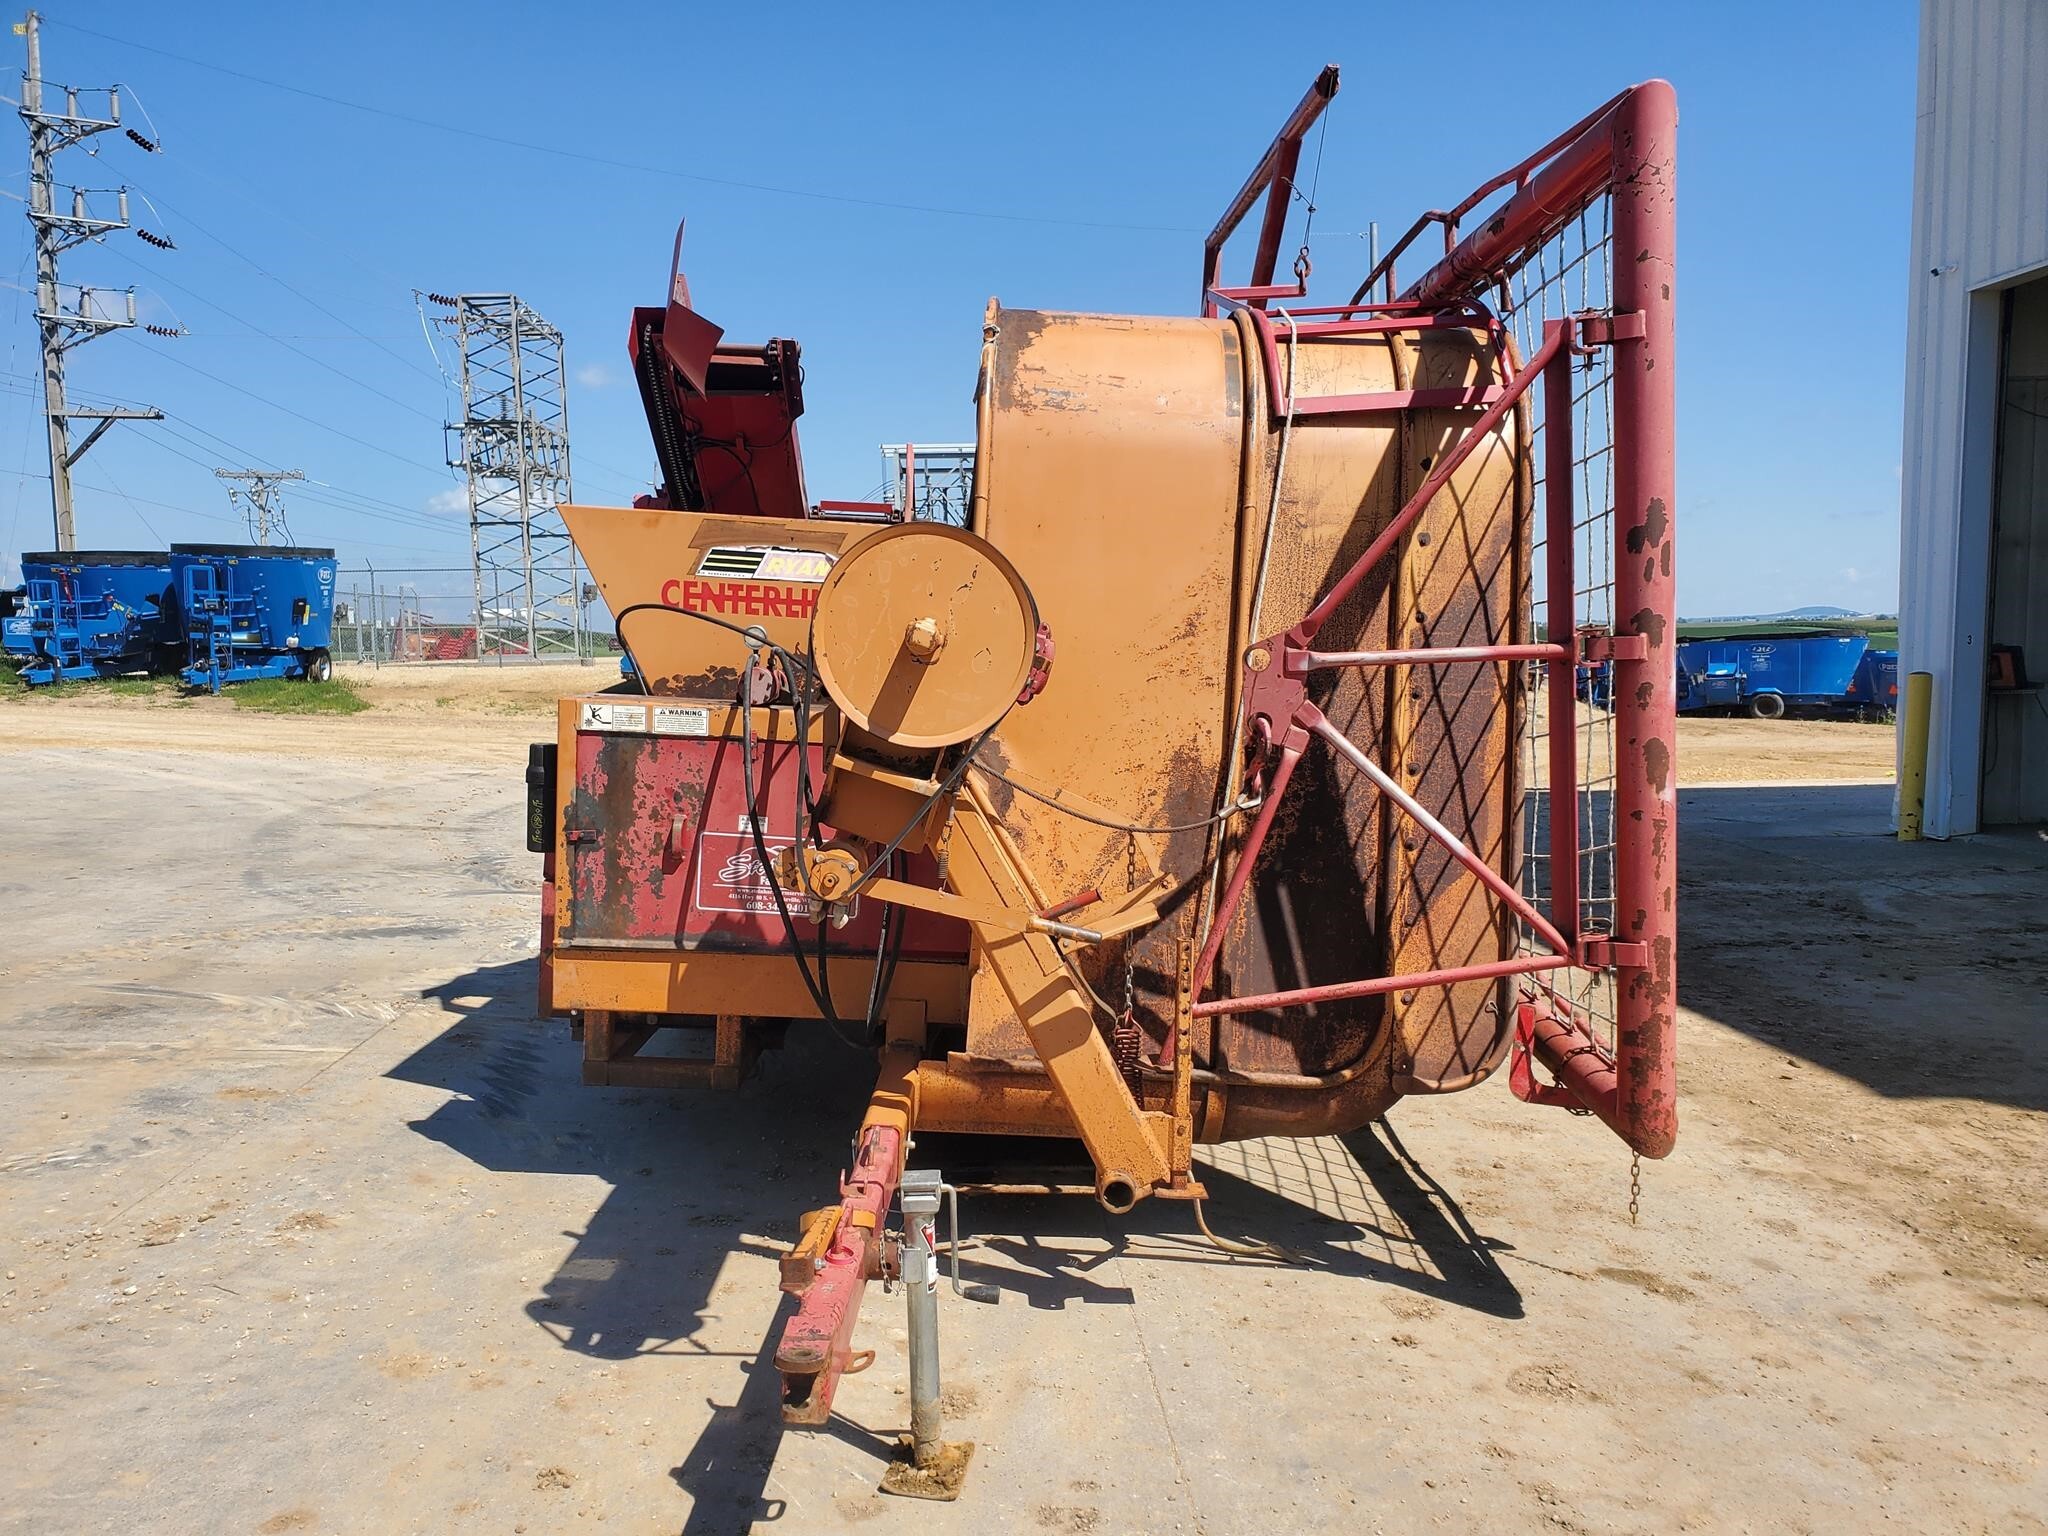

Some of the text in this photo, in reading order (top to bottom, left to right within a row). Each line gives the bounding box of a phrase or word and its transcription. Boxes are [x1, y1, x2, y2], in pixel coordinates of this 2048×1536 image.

[1967, 634, 1973, 645] 3
[668, 709, 703, 717] WARNING
[746, 901, 808, 913] 608-349401
